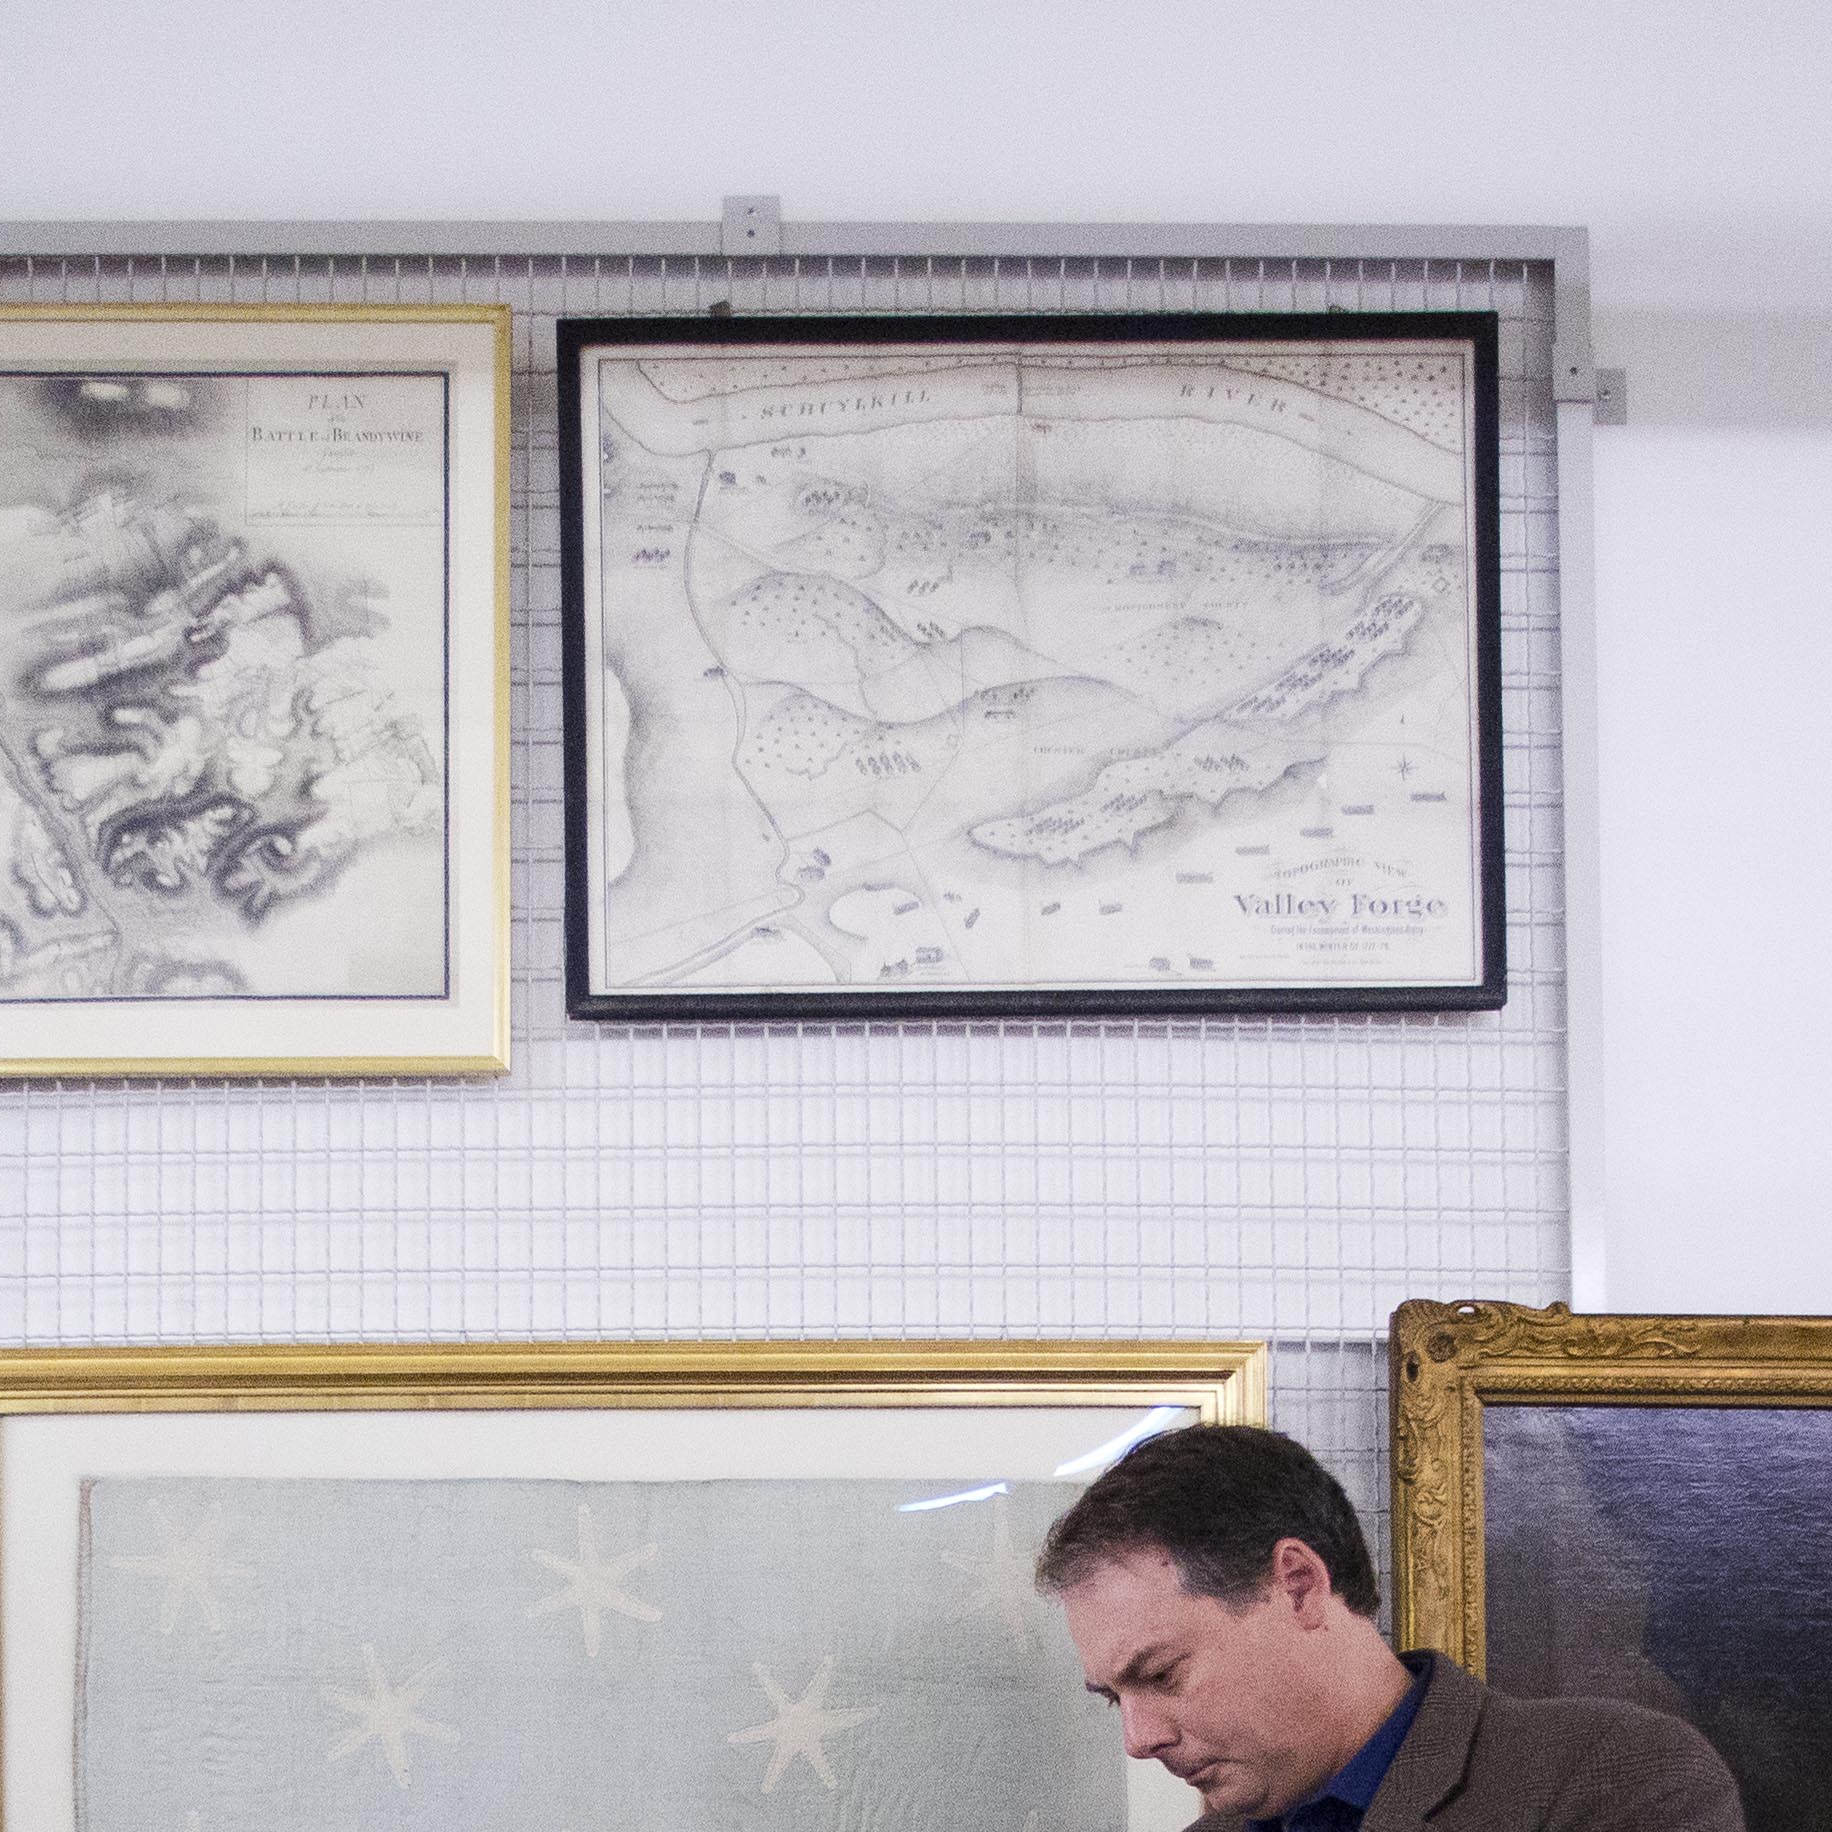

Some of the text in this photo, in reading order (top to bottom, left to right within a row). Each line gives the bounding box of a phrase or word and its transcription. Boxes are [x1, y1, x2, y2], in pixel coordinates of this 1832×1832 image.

[307, 394, 368, 410] PLAN
[1179, 383, 1288, 413] RIVER
[251, 426, 319, 442] BATTLE
[1233, 893, 1448, 922] Valley Forge
